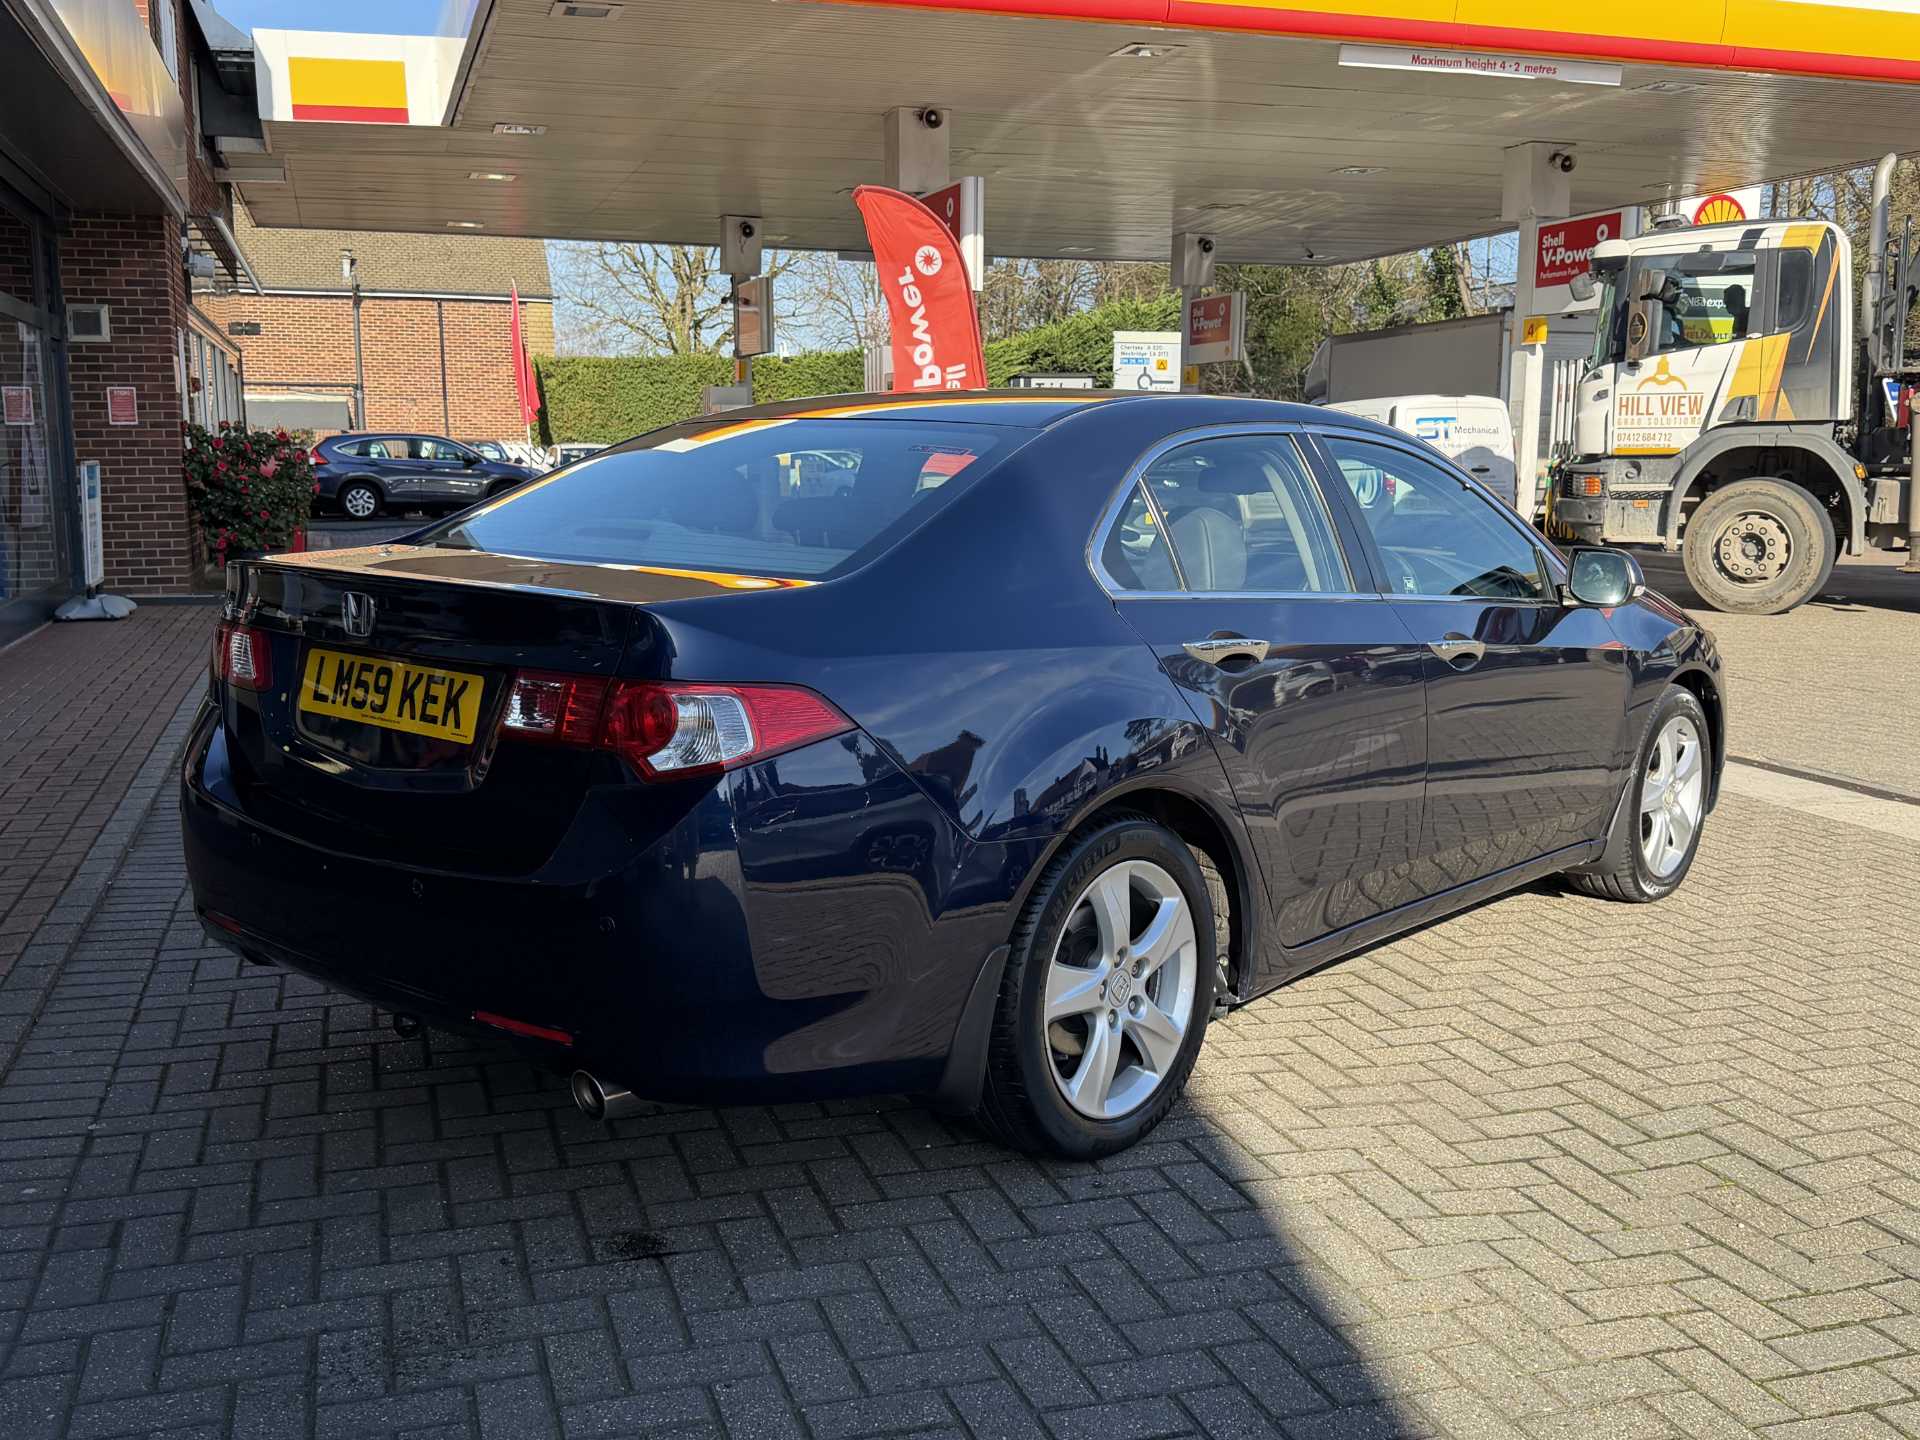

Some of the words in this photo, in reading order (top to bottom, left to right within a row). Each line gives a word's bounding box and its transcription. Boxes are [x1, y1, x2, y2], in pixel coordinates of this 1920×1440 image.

[1411, 54, 1463, 68] Maximum
[1465, 57, 1498, 72] height
[1524, 63, 1558, 75] metres
[1542, 231, 1565, 249] Shell
[1542, 246, 1595, 268] V-Powe
[1527, 322, 1535, 337] 4
[1618, 396, 1654, 416] HILL
[1660, 395, 1704, 416] VIEW
[1454, 425, 1499, 434] Mechanical
[1647, 416, 1702, 425] SOLUTIONS
[313, 655, 393, 714] LM59
[397, 670, 469, 730] KEK
